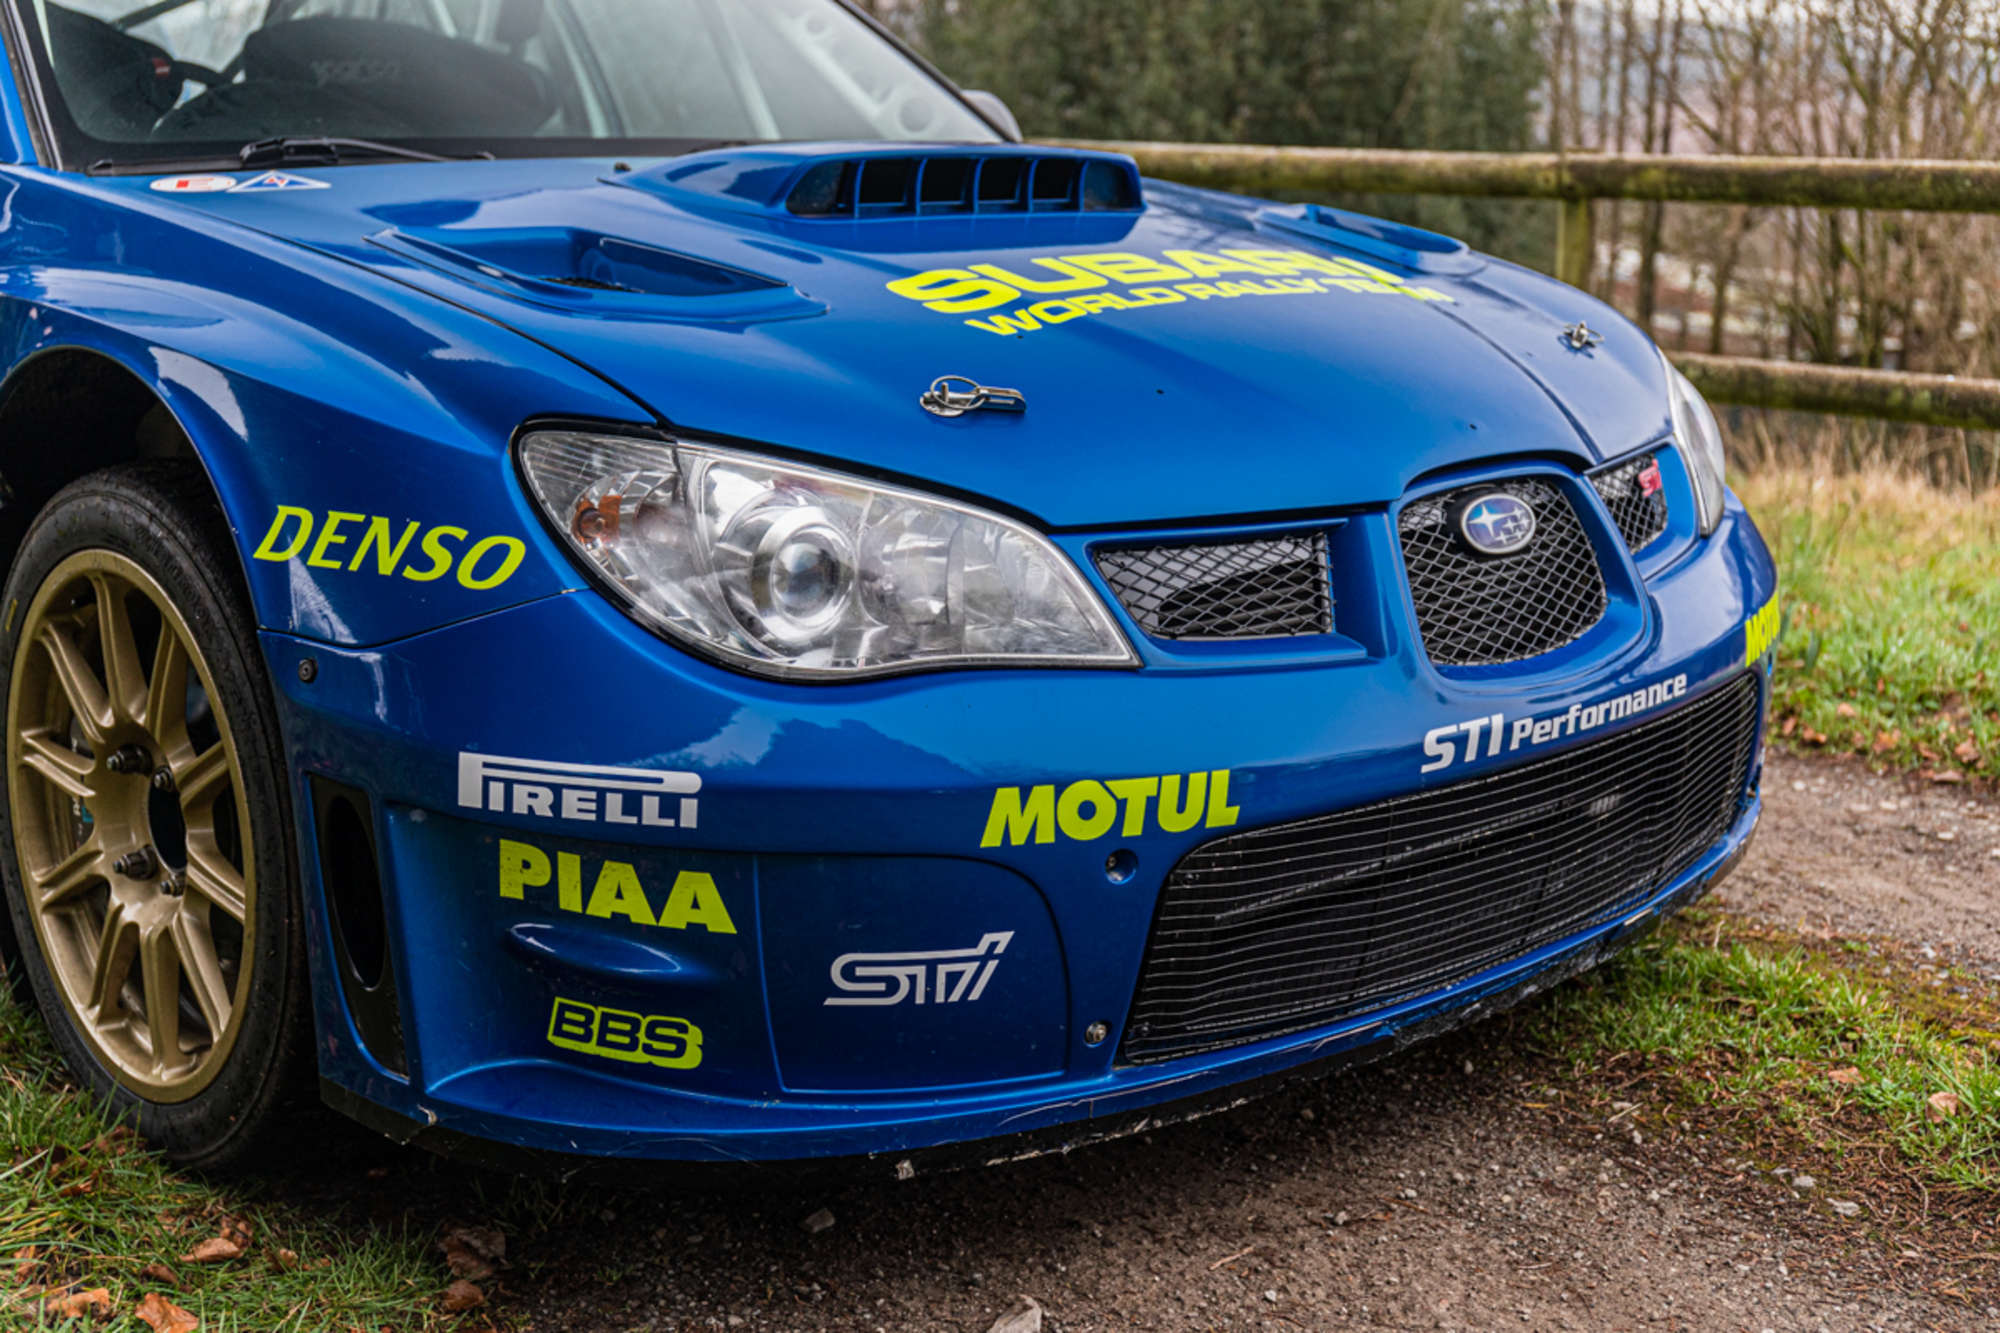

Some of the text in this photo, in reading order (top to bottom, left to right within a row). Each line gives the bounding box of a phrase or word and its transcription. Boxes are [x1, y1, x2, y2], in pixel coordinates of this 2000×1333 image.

[887, 250, 1404, 313] SUBARU
[964, 284, 1187, 336] WORLD
[1173, 278, 1328, 321] RALLY
[253, 505, 526, 590] DENSO
[1420, 673, 1688, 774] STI Performance
[457, 751, 703, 829] PIRELLI
[980, 768, 1240, 848] MOTUL
[499, 839, 737, 934] PIAA
[547, 997, 704, 1070] BBS
